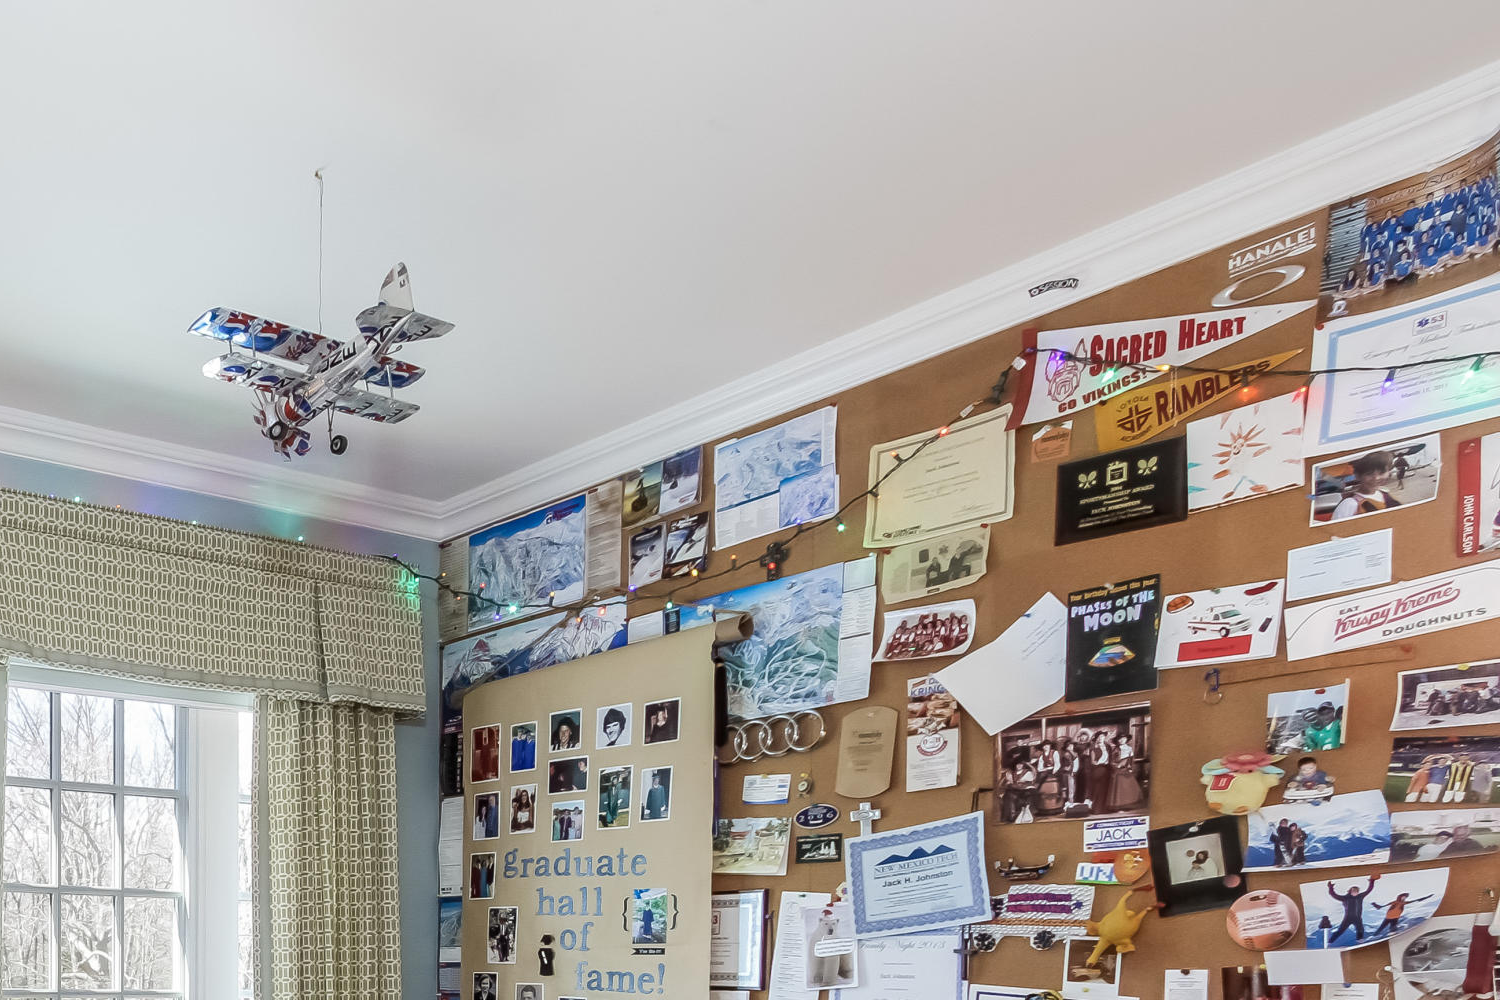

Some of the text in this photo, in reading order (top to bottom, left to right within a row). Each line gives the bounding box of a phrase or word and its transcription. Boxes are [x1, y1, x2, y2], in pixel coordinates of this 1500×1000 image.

[1228, 227, 1316, 271] HANALEI
[1430, 314, 1445, 325] 53
[1089, 316, 1247, 377] SACRED HEART
[1057, 368, 1149, 414] GO VIKINGS!
[1154, 360, 1272, 426] RAMBLERS
[1462, 494, 1475, 554] JOHN CARLSON
[1071, 590, 1156, 618] PHASES OF THE
[1083, 603, 1143, 632] MOON
[1334, 580, 1461, 643] Krispy Kreme
[1339, 605, 1361, 616] EAT
[1381, 607, 1488, 638] DOUGHNUTS
[1095, 828, 1133, 842] JACK
[503, 848, 648, 879] graduate
[874, 852, 959, 875] NEW MEXICO TECH
[882, 879, 902, 888] Jack
[916, 870, 954, 882] Johnston
[536, 886, 604, 916] hall
[559, 922, 595, 951] of
[574, 960, 666, 994] fame!
